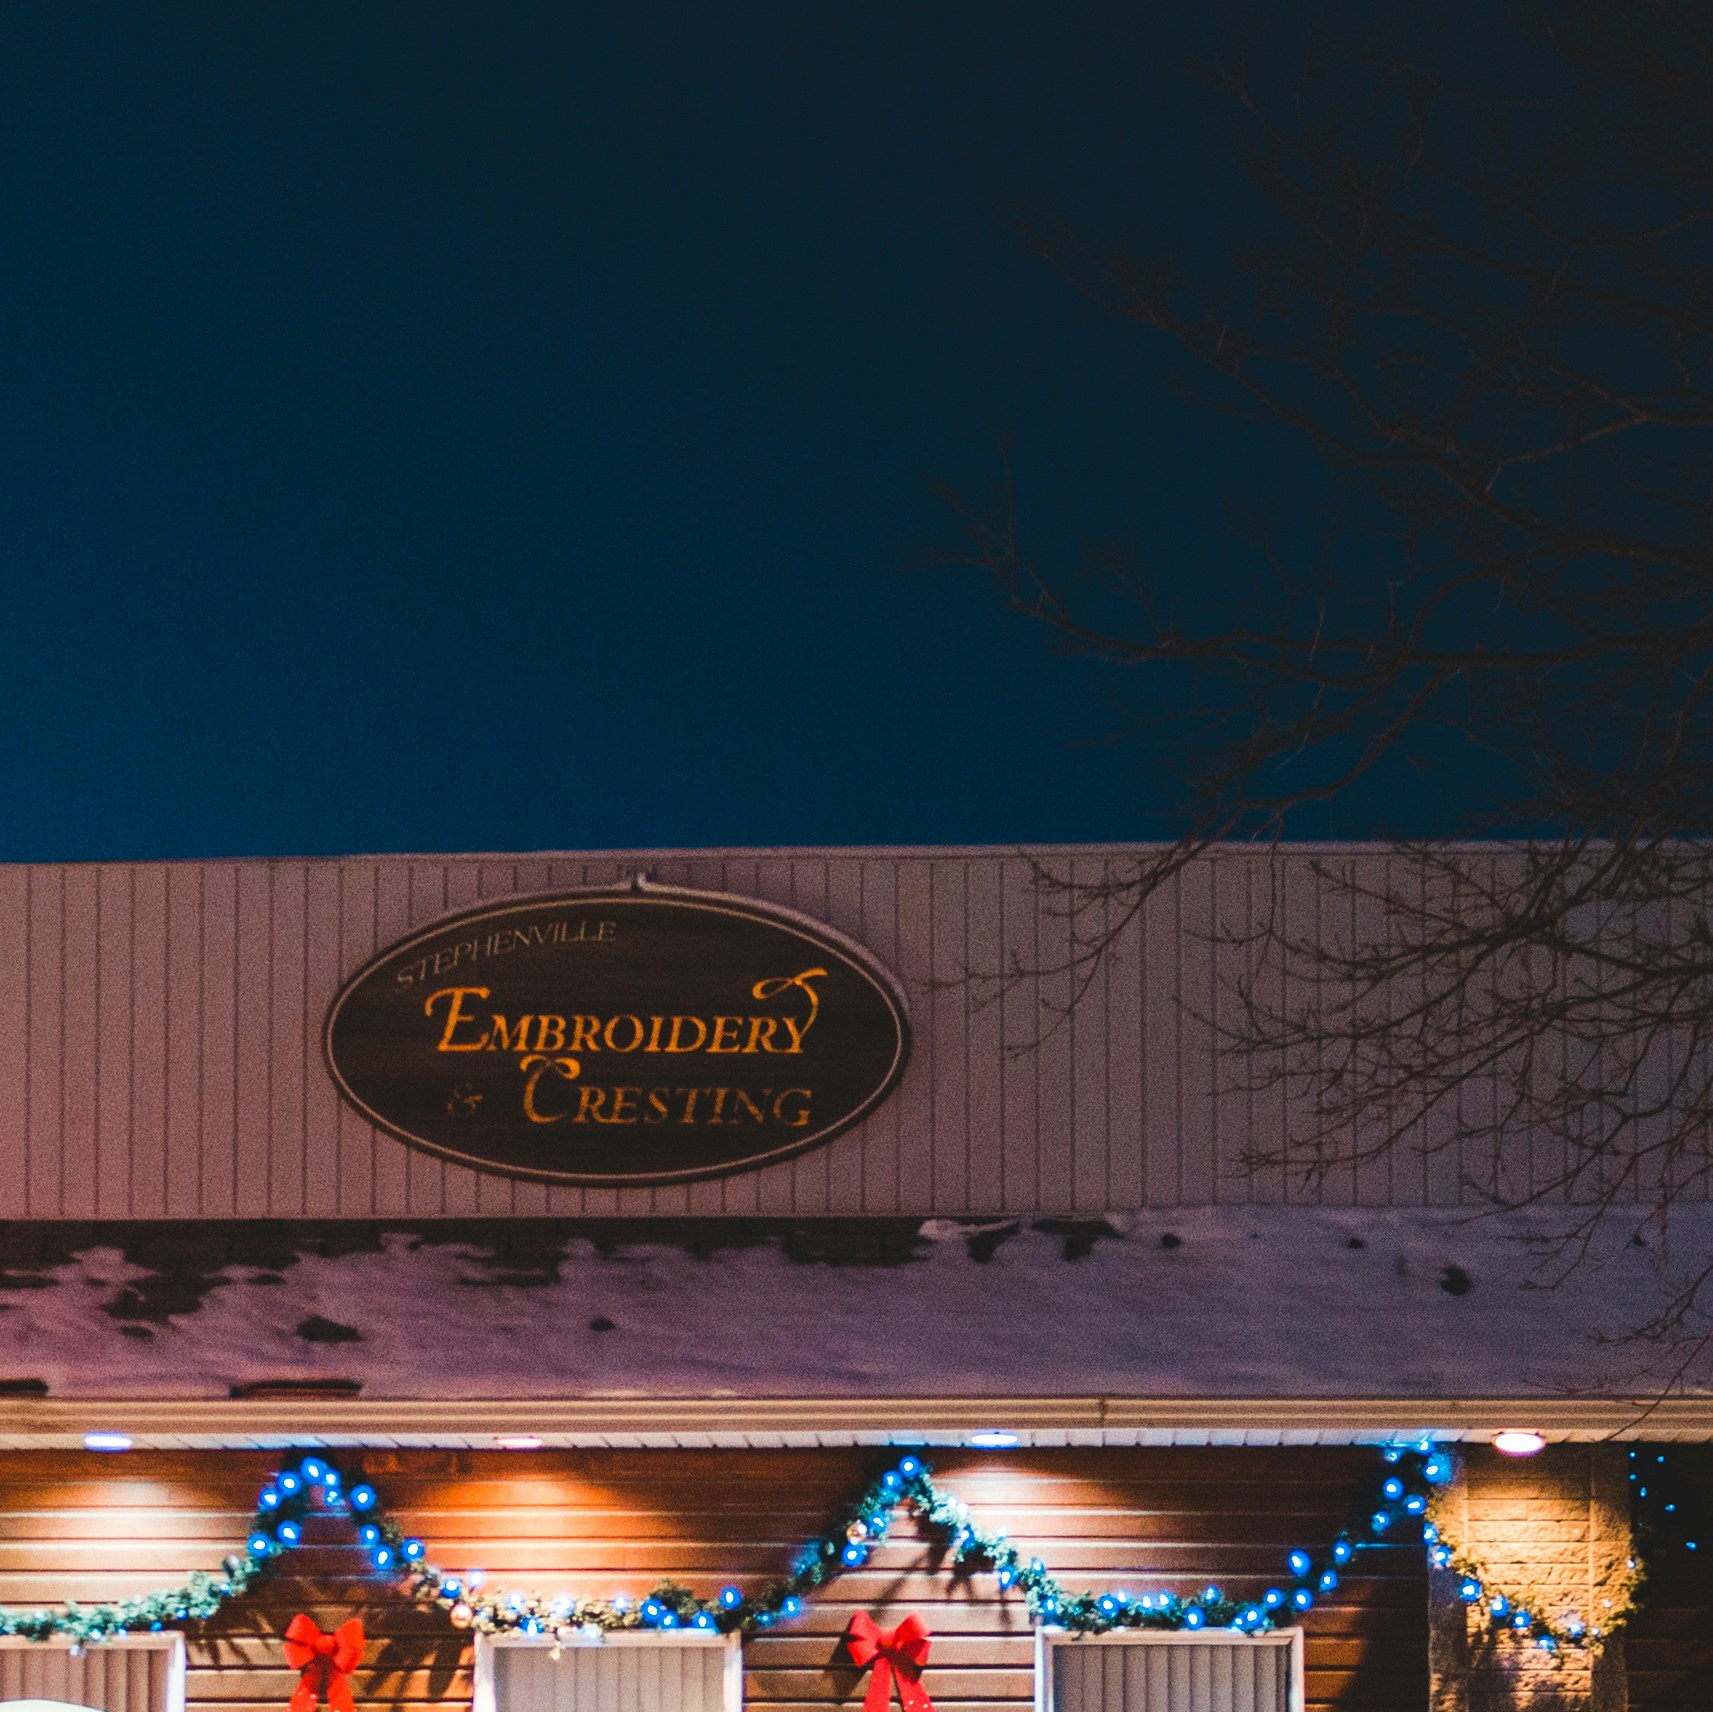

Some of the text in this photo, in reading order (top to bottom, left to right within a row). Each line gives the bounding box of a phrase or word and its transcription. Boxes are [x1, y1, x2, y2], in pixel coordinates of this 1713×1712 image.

[393, 921, 618, 993] STEPHENVILLE
[424, 967, 829, 1054] EMBROIDERY
[519, 1054, 814, 1127] CRESTING
